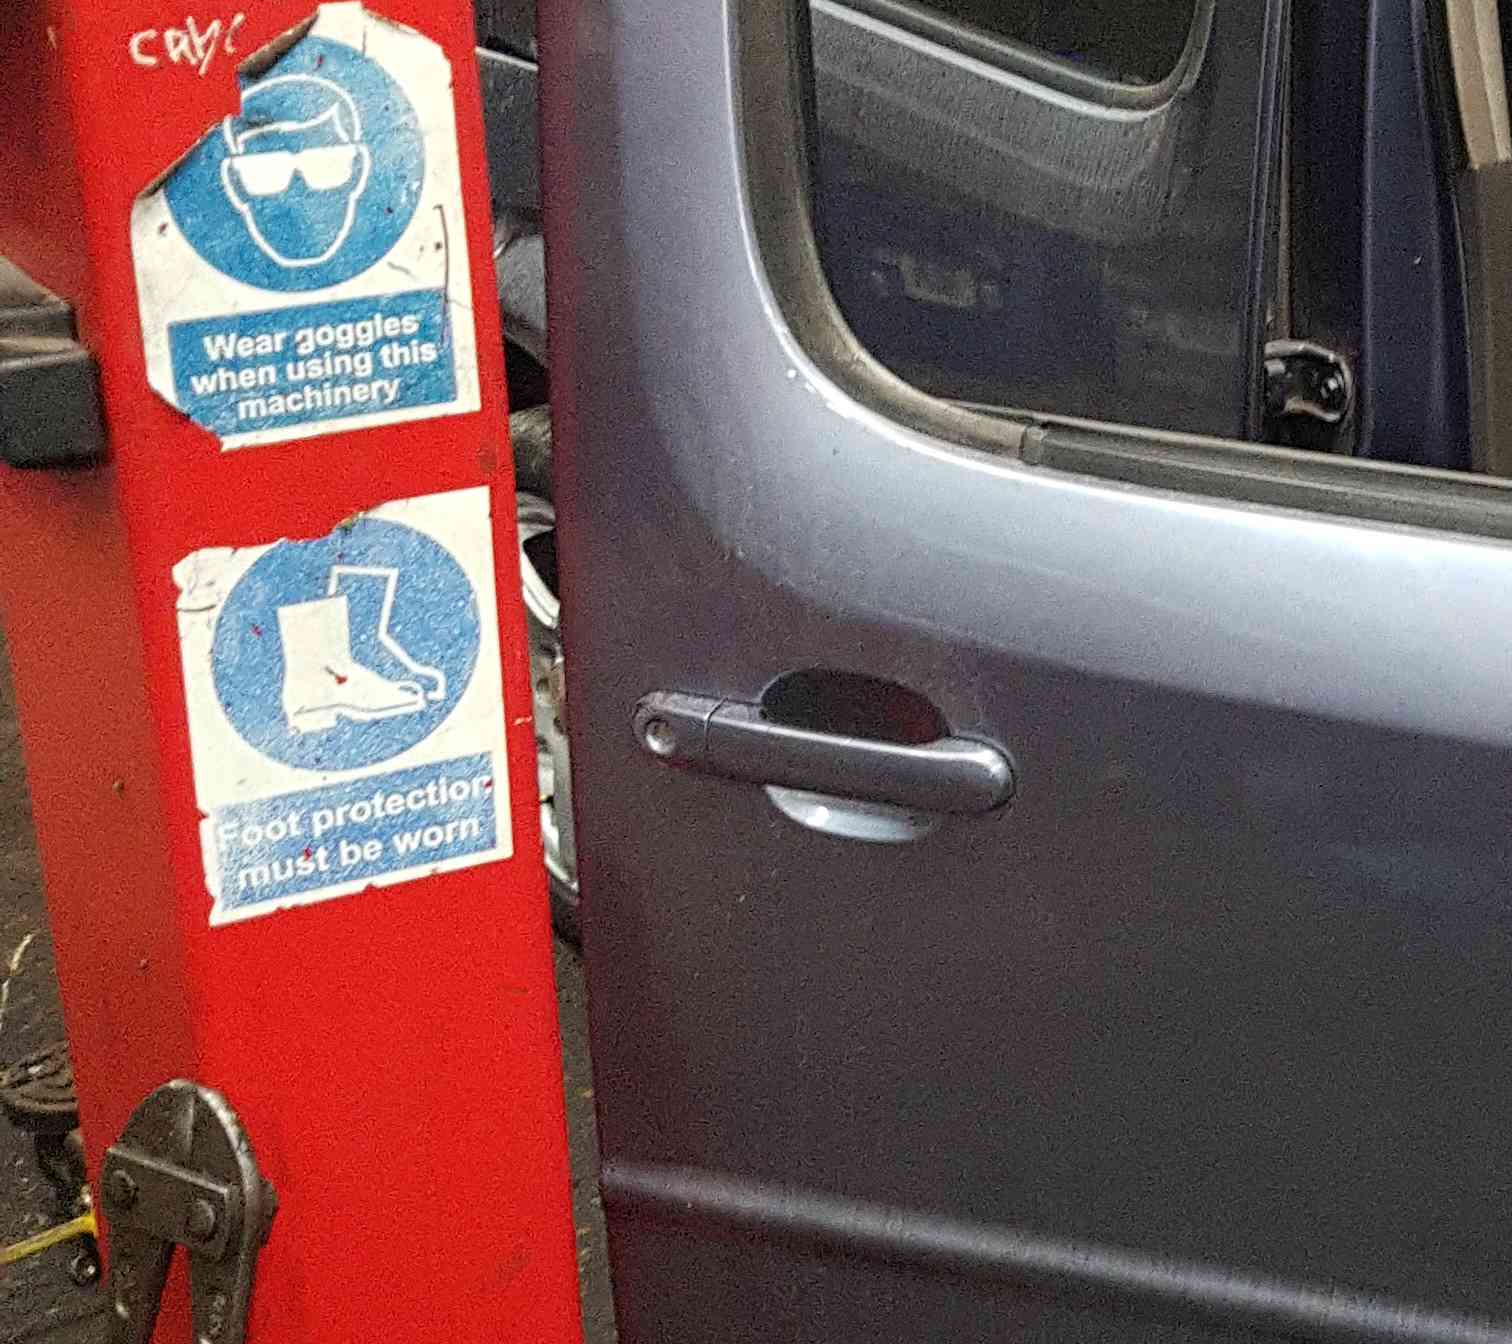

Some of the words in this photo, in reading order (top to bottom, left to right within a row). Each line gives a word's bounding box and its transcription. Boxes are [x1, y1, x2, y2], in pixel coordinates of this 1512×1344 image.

[203, 330, 287, 362] Wear
[294, 313, 421, 355] goggles
[191, 363, 277, 395] when
[287, 350, 375, 382] using
[379, 339, 438, 369] this
[237, 376, 402, 421] machinery
[217, 812, 301, 851] Foot
[312, 774, 493, 838] protection
[238, 848, 330, 889] must
[338, 838, 384, 867] be
[392, 815, 481, 855] worn
